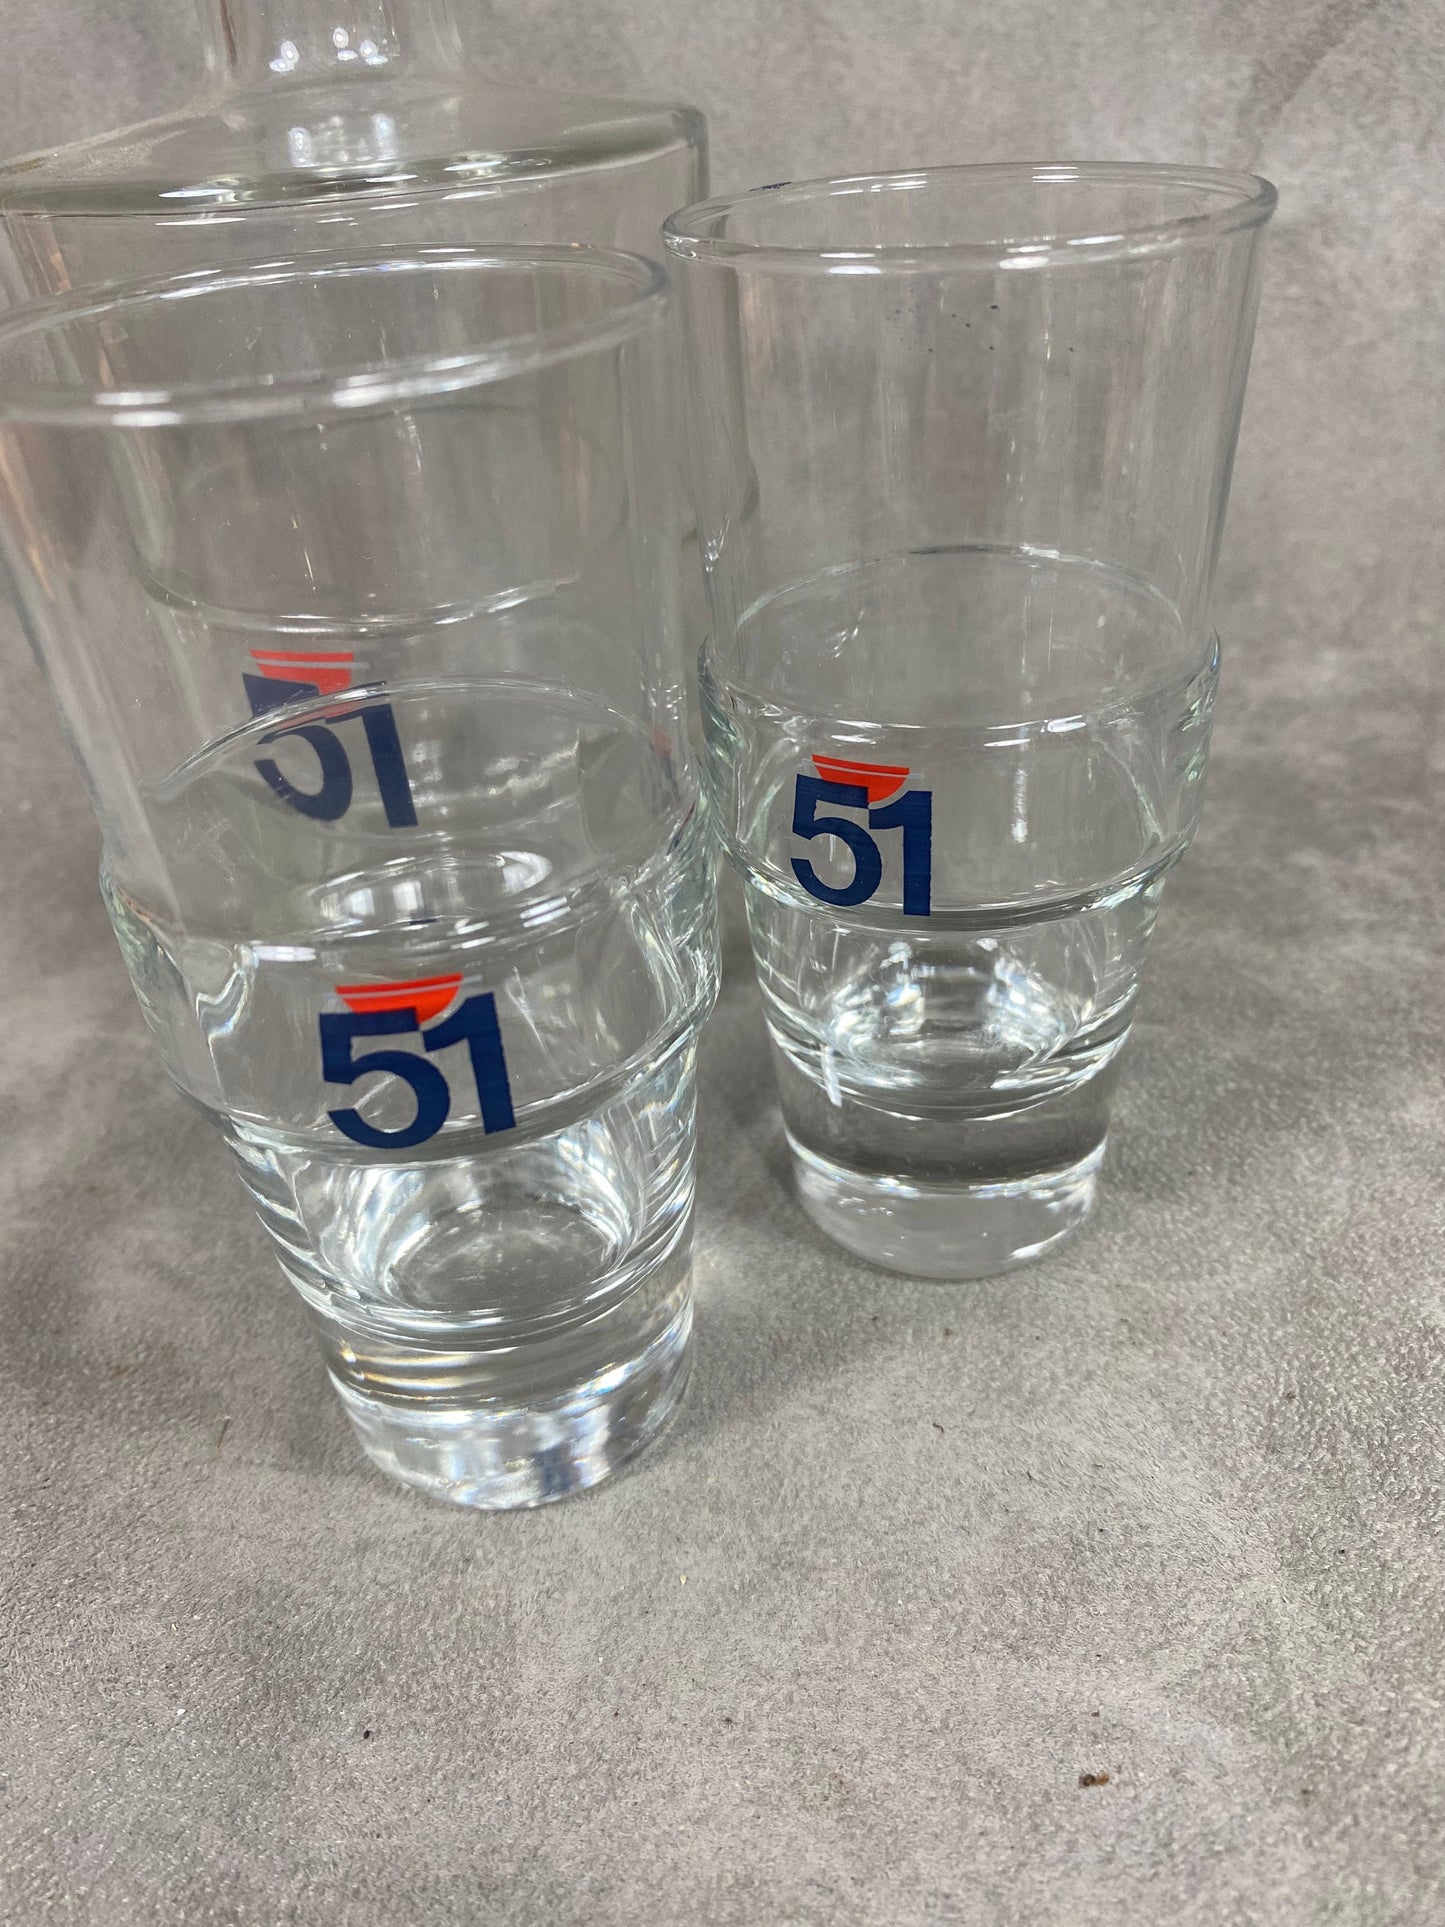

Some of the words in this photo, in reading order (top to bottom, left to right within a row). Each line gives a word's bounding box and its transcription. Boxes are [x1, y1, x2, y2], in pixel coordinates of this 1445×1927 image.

[242, 673, 418, 828] 51
[791, 774, 932, 916] 51
[320, 993, 516, 1149] 51
